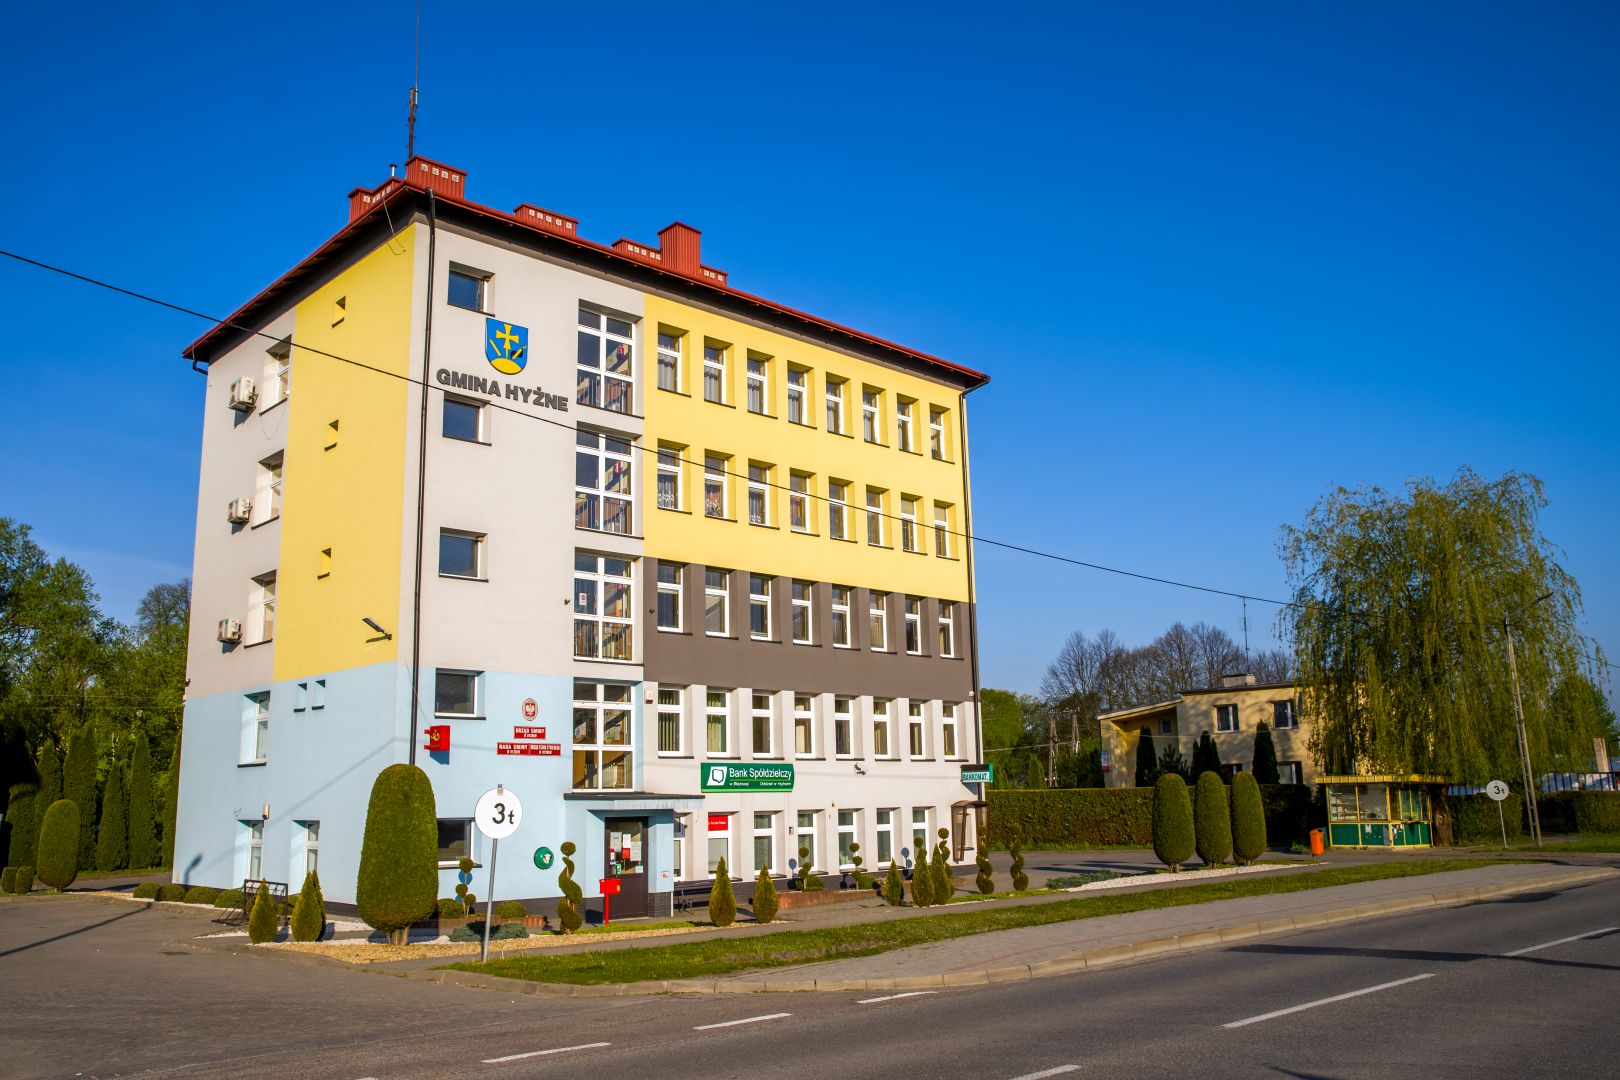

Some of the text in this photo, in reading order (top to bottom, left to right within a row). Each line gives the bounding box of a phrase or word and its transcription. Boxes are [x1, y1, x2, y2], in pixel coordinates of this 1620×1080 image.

[436, 368, 569, 413] GMINA HYŻNE
[729, 767, 792, 781] Bank Spółdzielczy
[962, 772, 987, 781] BANKOMAT
